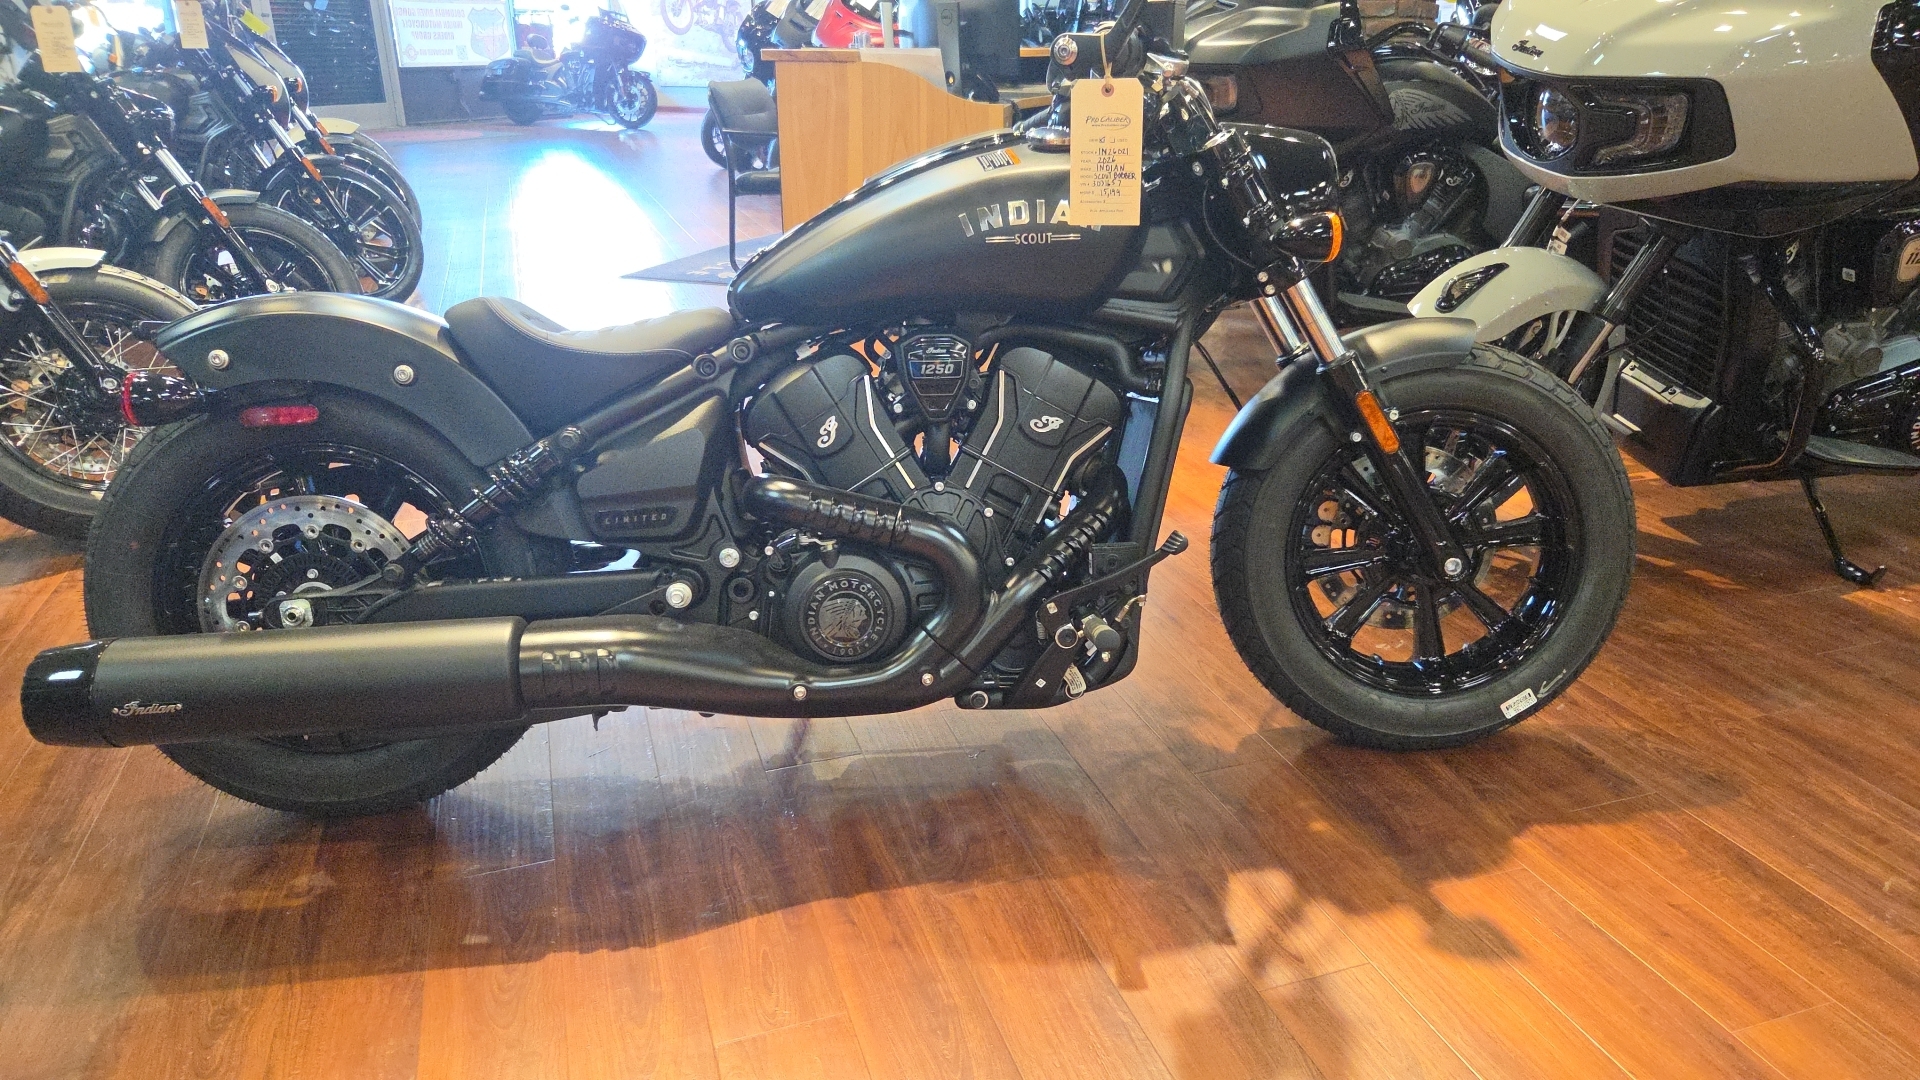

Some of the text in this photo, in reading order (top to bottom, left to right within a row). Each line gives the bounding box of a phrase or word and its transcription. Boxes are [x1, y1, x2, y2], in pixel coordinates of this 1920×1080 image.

[1097, 156, 1116, 164] 2026
[1096, 164, 1125, 172] INDIAN
[1113, 172, 1137, 180] BOBBER
[958, 199, 1102, 237] INDIA
[1014, 232, 1053, 245] SCOUT
[920, 363, 955, 375] 1250
[605, 513, 667, 525] LIMITED
[807, 580, 885, 642] INDIAN MOTORCYCLE
[118, 698, 177, 717] Indian
